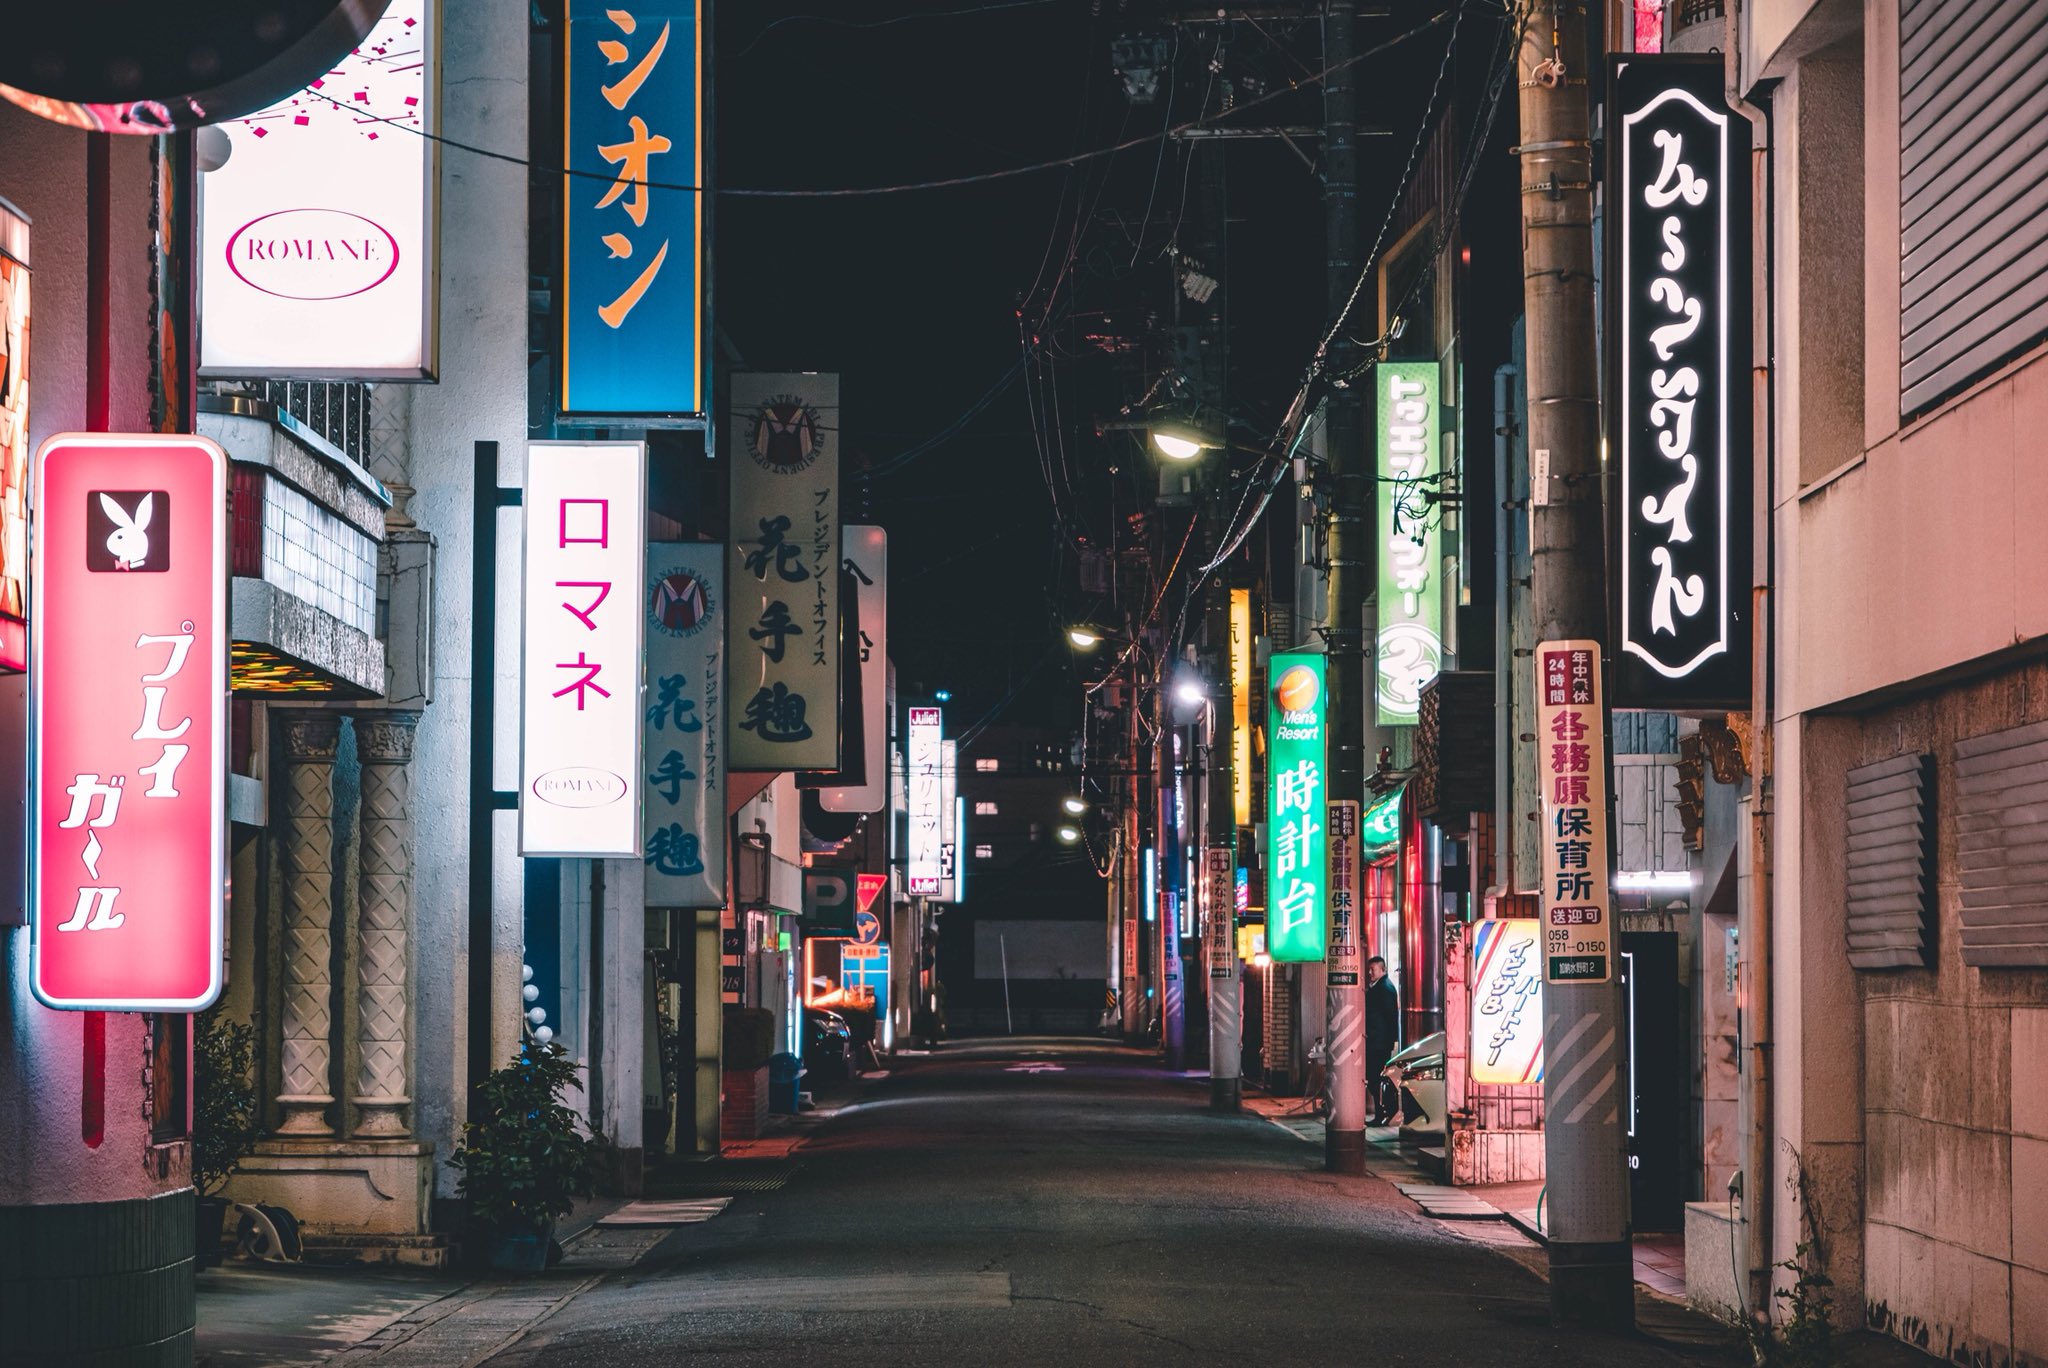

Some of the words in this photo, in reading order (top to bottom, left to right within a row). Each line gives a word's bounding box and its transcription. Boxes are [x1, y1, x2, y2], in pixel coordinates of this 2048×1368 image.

[593, 8, 672, 329] シオン
[248, 238, 380, 261] ROMANE
[551, 498, 612, 711] ロマネ
[812, 487, 831, 666] プレジデントオフィス
[131, 619, 196, 798] プレイ
[911, 710, 938, 726] Juliet
[1282, 711, 1317, 725] Men's
[1548, 658, 1566, 704] 24時間
[705, 653, 719, 791] プレジデントオフィス
[1277, 725, 1319, 741] Resort
[1551, 710, 1593, 901] 各務原保育所
[1275, 759, 1320, 935] 時計台
[806, 875, 848, 919] P
[1331, 838, 1353, 943] 各務原保育所
[1552, 908, 1600, 924] 送迎可
[1548, 929, 1569, 941] 058
